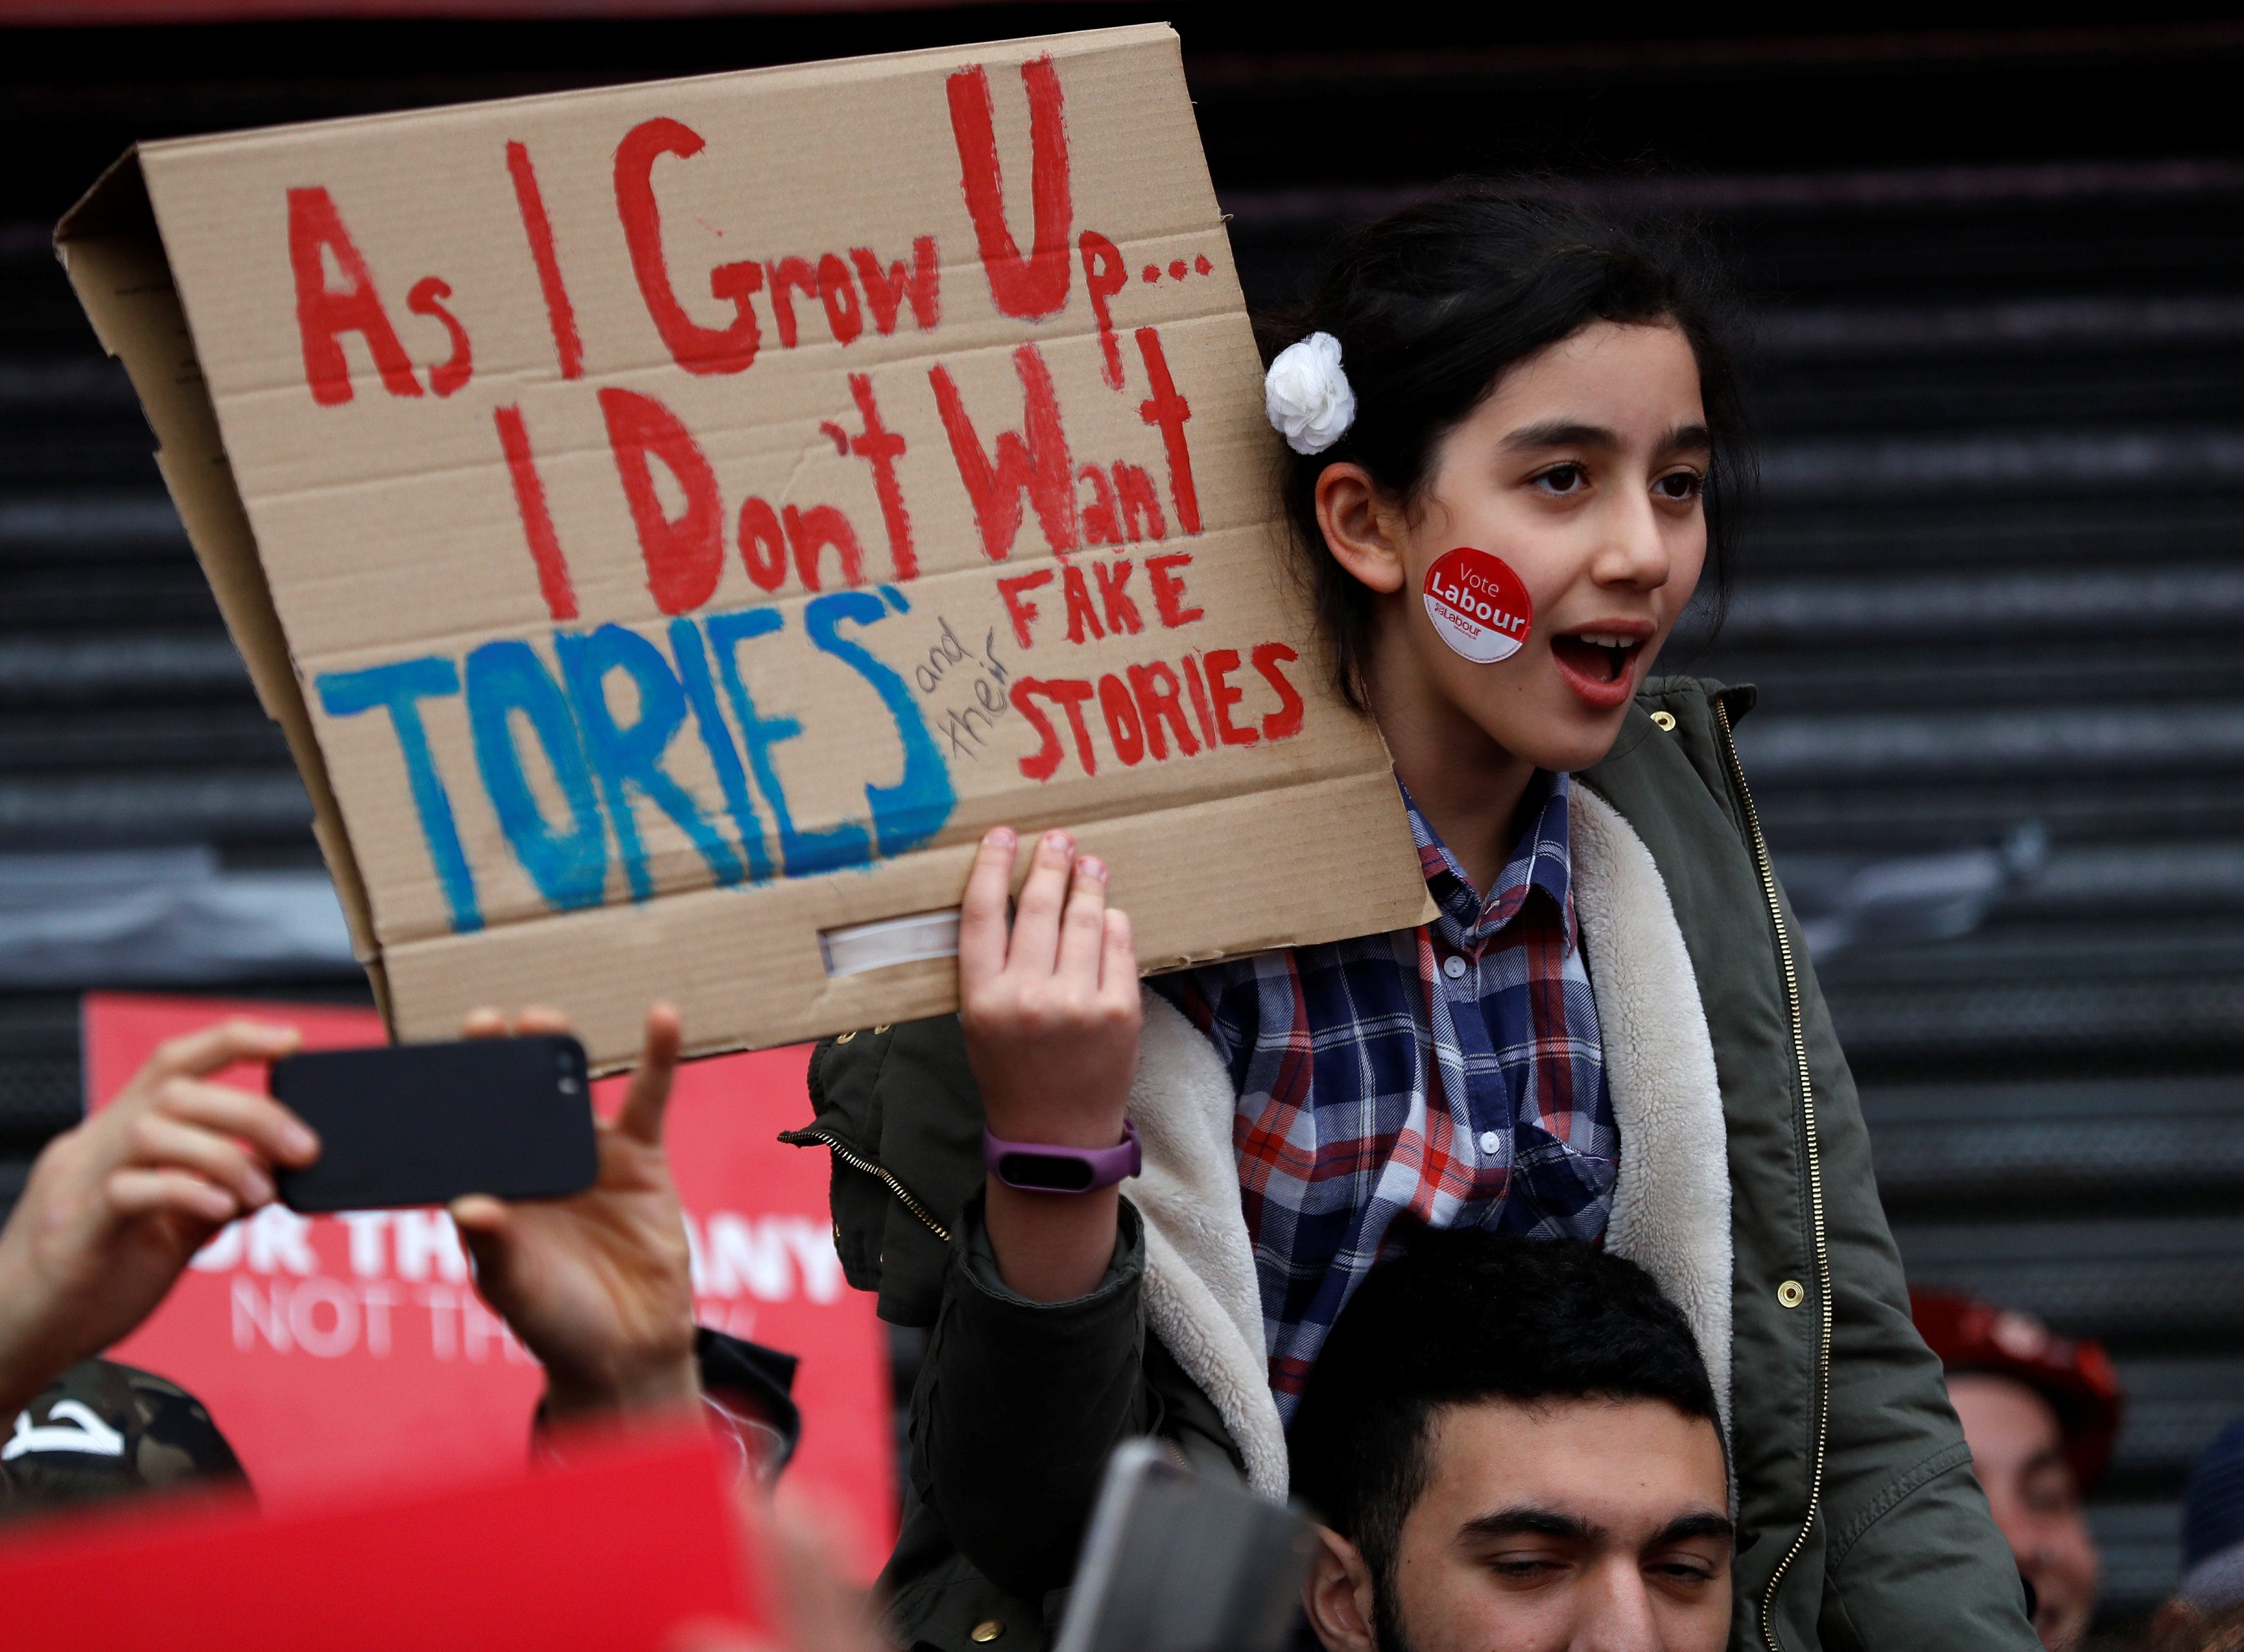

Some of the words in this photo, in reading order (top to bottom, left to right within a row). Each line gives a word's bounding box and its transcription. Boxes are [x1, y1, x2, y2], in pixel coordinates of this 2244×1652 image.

[286, 186, 473, 406] As
[506, 138, 584, 380] I
[612, 117, 941, 376] Grow
[495, 401, 578, 621] I
[597, 371, 919, 615] Don't
[928, 326, 1203, 564] Want
[997, 552, 1205, 650] FAKE
[1431, 571, 1525, 633] Labour
[1443, 608, 1482, 637] Labour
[1460, 562, 1499, 597] Vote
[916, 616, 975, 694] and
[936, 626, 1008, 762] their
[1009, 641, 1305, 784] STORIES
[333, 1208, 478, 1283] TH
[230, 1276, 403, 1359] NOT
[414, 1283, 544, 1365] TH
